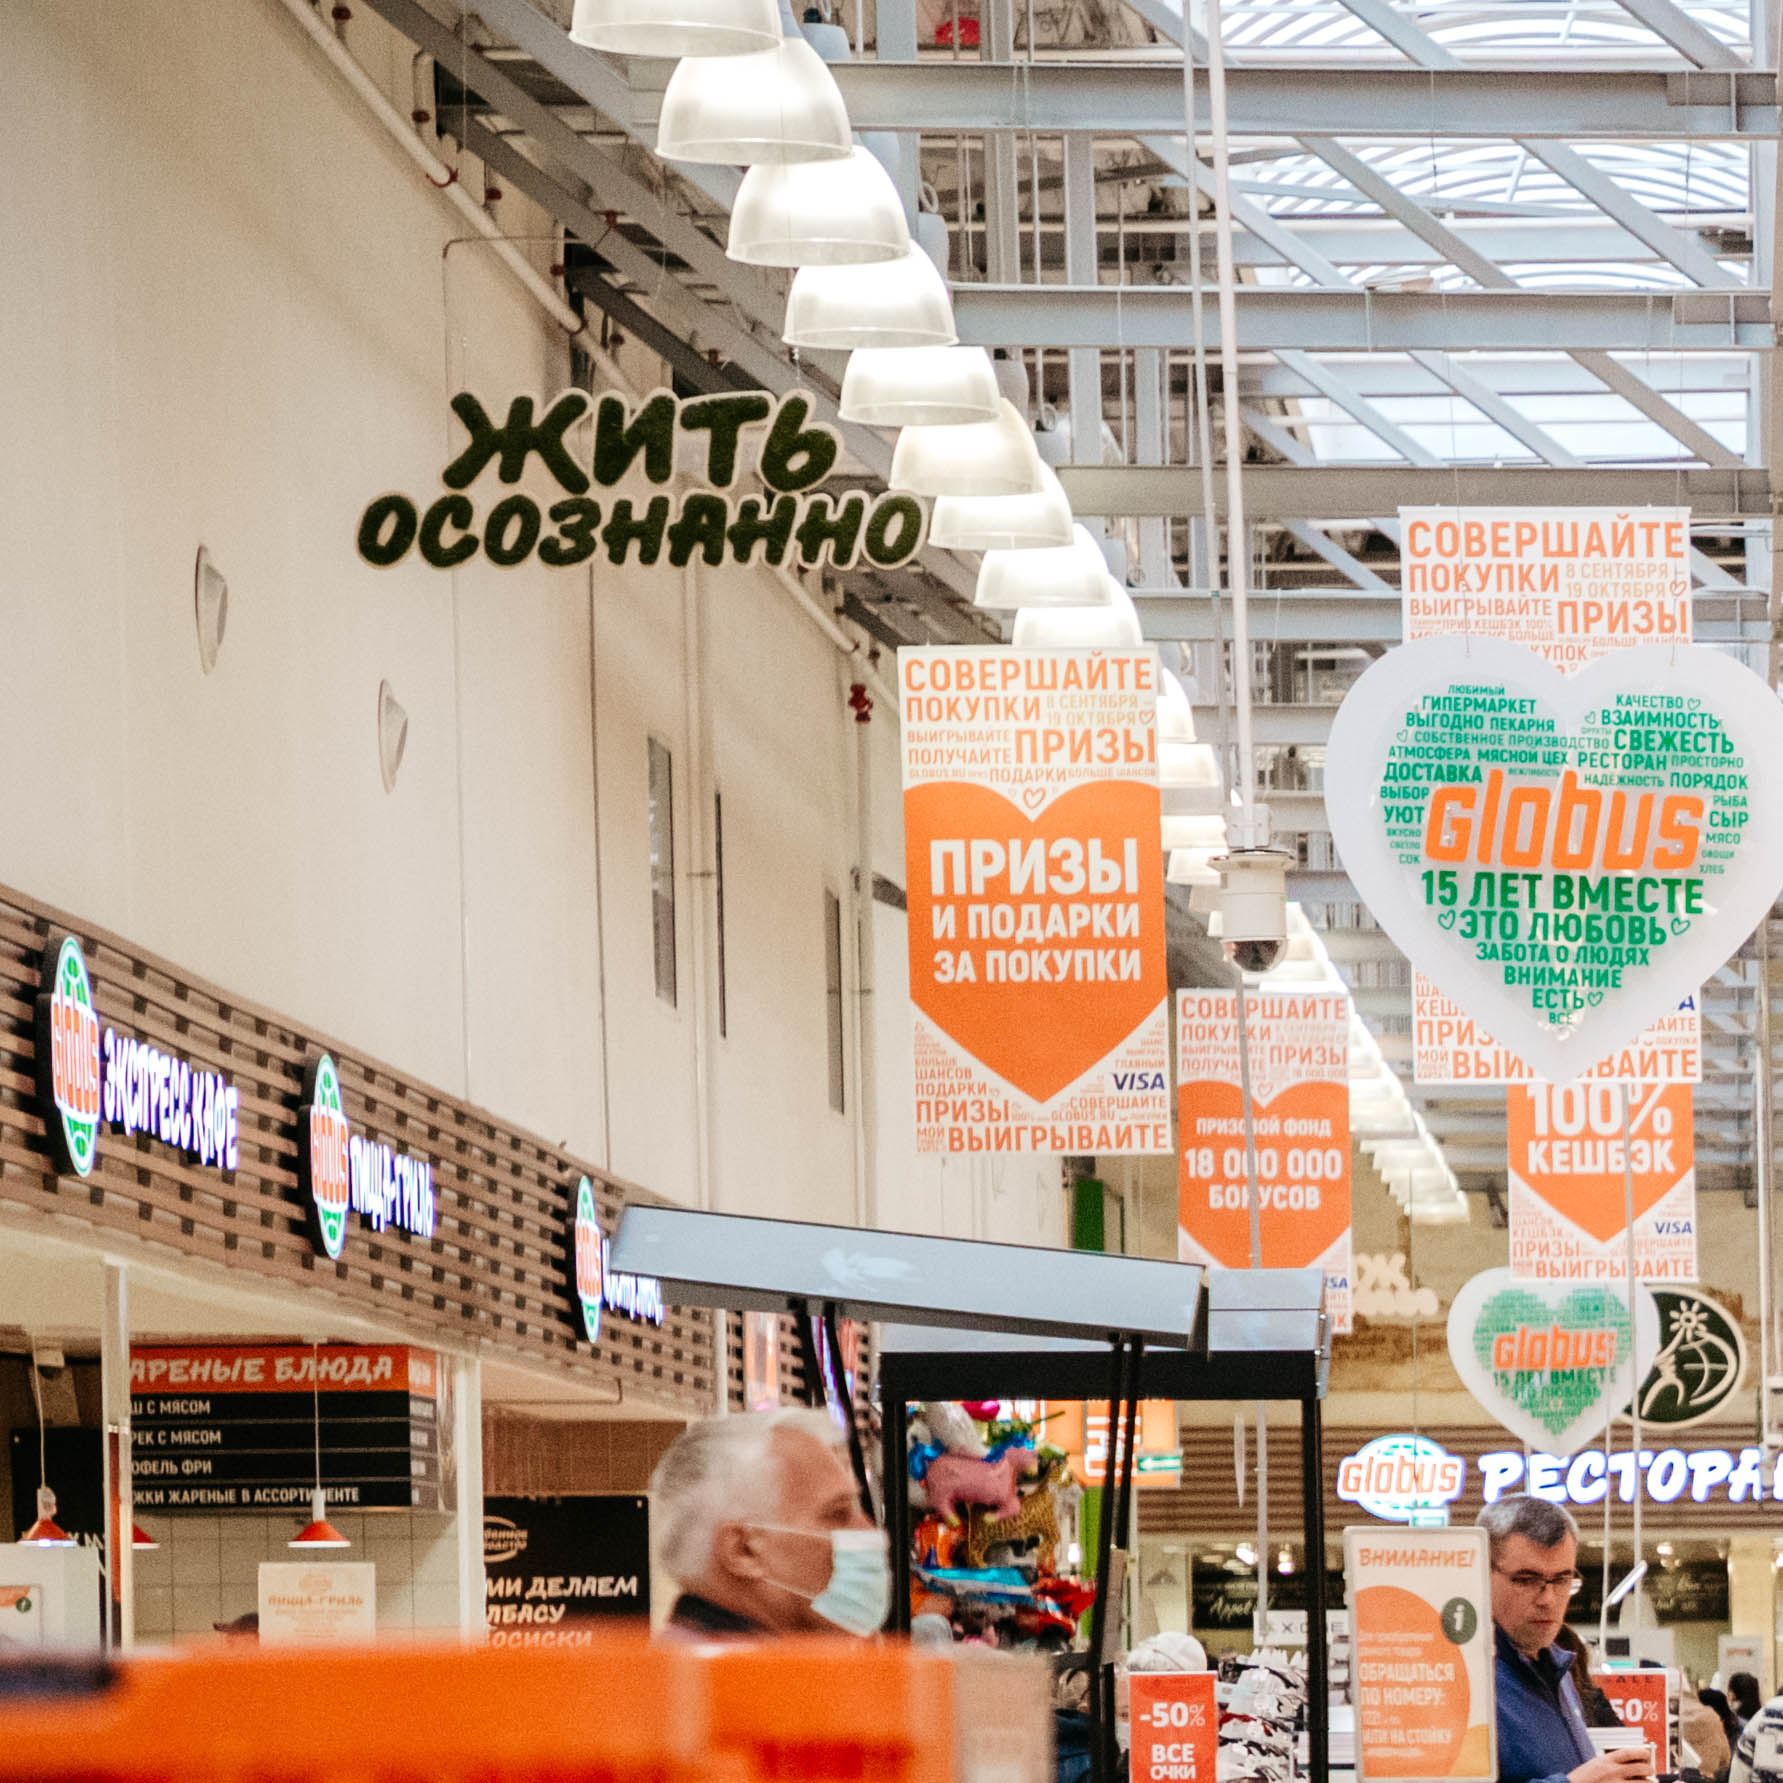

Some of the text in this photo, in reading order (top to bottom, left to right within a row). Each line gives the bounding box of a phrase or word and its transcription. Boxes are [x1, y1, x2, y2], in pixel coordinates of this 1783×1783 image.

[443, 391, 843, 494] ЖИТЬ
[358, 493, 922, 567] ОСОЗНАННО
[1408, 514, 1685, 559] СОВЕРШАЙТЕ
[1409, 563, 1559, 593] ПОКУПКИ
[1580, 562, 1669, 579] СЕНТЯБРЯ
[1588, 582, 1666, 598] ОКТЯБРЯ
[1409, 595, 1552, 617] ВЫИГРЫВАЙТЕ
[1557, 601, 1688, 634] ПРИЗЫ
[905, 650, 1153, 692] СОВЕРШАЙТЕ
[906, 697, 1041, 723] ПОКУПКИ
[1422, 695, 1537, 715] ГИПЕРМАРКЕТ
[1616, 693, 1684, 709] КАЧЕСТВО
[1405, 711, 1556, 733] ВЫГОДНО ПЕКАРНЯ
[1601, 709, 1720, 730] ВЗАИМНОСТЬ
[1014, 728, 1156, 764] ПРИЗЫ
[1414, 730, 1505, 746] СОБСТВЕННОЕ
[1613, 728, 1735, 755] СВЕЖЕСТЬ
[908, 745, 1012, 765] ПОЛУЧАЙТЕ
[1388, 745, 1568, 766] АТМОСФЕРА МЯСНОЙ ЦЕХ
[1577, 751, 1745, 771] РЕСТОРАН ПРОСТОРНО
[989, 767, 1067, 784] ПОДАРКИ
[1383, 762, 1483, 784] ДОСТАВКА
[1669, 771, 1749, 792] ПОРЯДОК
[1379, 785, 1430, 800] ВЫБОР
[1712, 795, 1748, 808] РЫБА
[1383, 805, 1425, 824] УЮТ
[1709, 810, 1750, 829] СЫР
[1705, 832, 1742, 845] МЯСО
[930, 838, 1139, 896] ПРИЗЫ
[1421, 869, 1704, 915] 15 ЛЕТ ВМЕСТЕ
[931, 903, 1140, 944] И ПОДАРКИ
[1459, 909, 1668, 946] ЭТО ЛЮБОВЬ
[1476, 941, 1650, 968] ЗАБОТА ЛЮДЯХ
[933, 949, 1142, 983] ЗА ПОКУПКИ
[1504, 965, 1623, 989] ВНИМАНИЕ
[1532, 987, 1586, 1010] ЕСТЬ
[1269, 1045, 1347, 1066] ПРИЗЫ
[1111, 1072, 1166, 1091] VISA
[916, 1099, 1010, 1123] ПРИЗЫ
[1526, 1083, 1673, 1136] 100%
[949, 1123, 1168, 1152] ВЫИГРЫВАЙТЕ
[1284, 1118, 1332, 1137] ФОНД
[1185, 1148, 1342, 1180] 18 000
[1527, 1139, 1676, 1175] КЕШБЭК
[1655, 1221, 1692, 1235] VISA
[1512, 1240, 1580, 1257] ПРИЗЫ
[131, 1355, 393, 1385] АРЕНЫЕ БЛЮДА
[160, 1399, 212, 1416] МЯСОМ
[170, 1429, 222, 1446] МЯСОМ
[182, 1459, 213, 1474] ФРИ
[168, 1487, 251, 1505] ЖАРЕНЫЕ В
[1358, 1547, 1477, 1569] ВНИМАНИЕ!
[525, 1575, 639, 1600] ДЕЛАЕМ
[1359, 1662, 1455, 1684] ОБРАЩАТЬСЯ
[1361, 1686, 1380, 1705] ПО
[1139, 1701, 1207, 1728] -50%
[1151, 1743, 1196, 1764] ВСЕ
[1150, 1764, 1196, 1781] ОЧКИ
